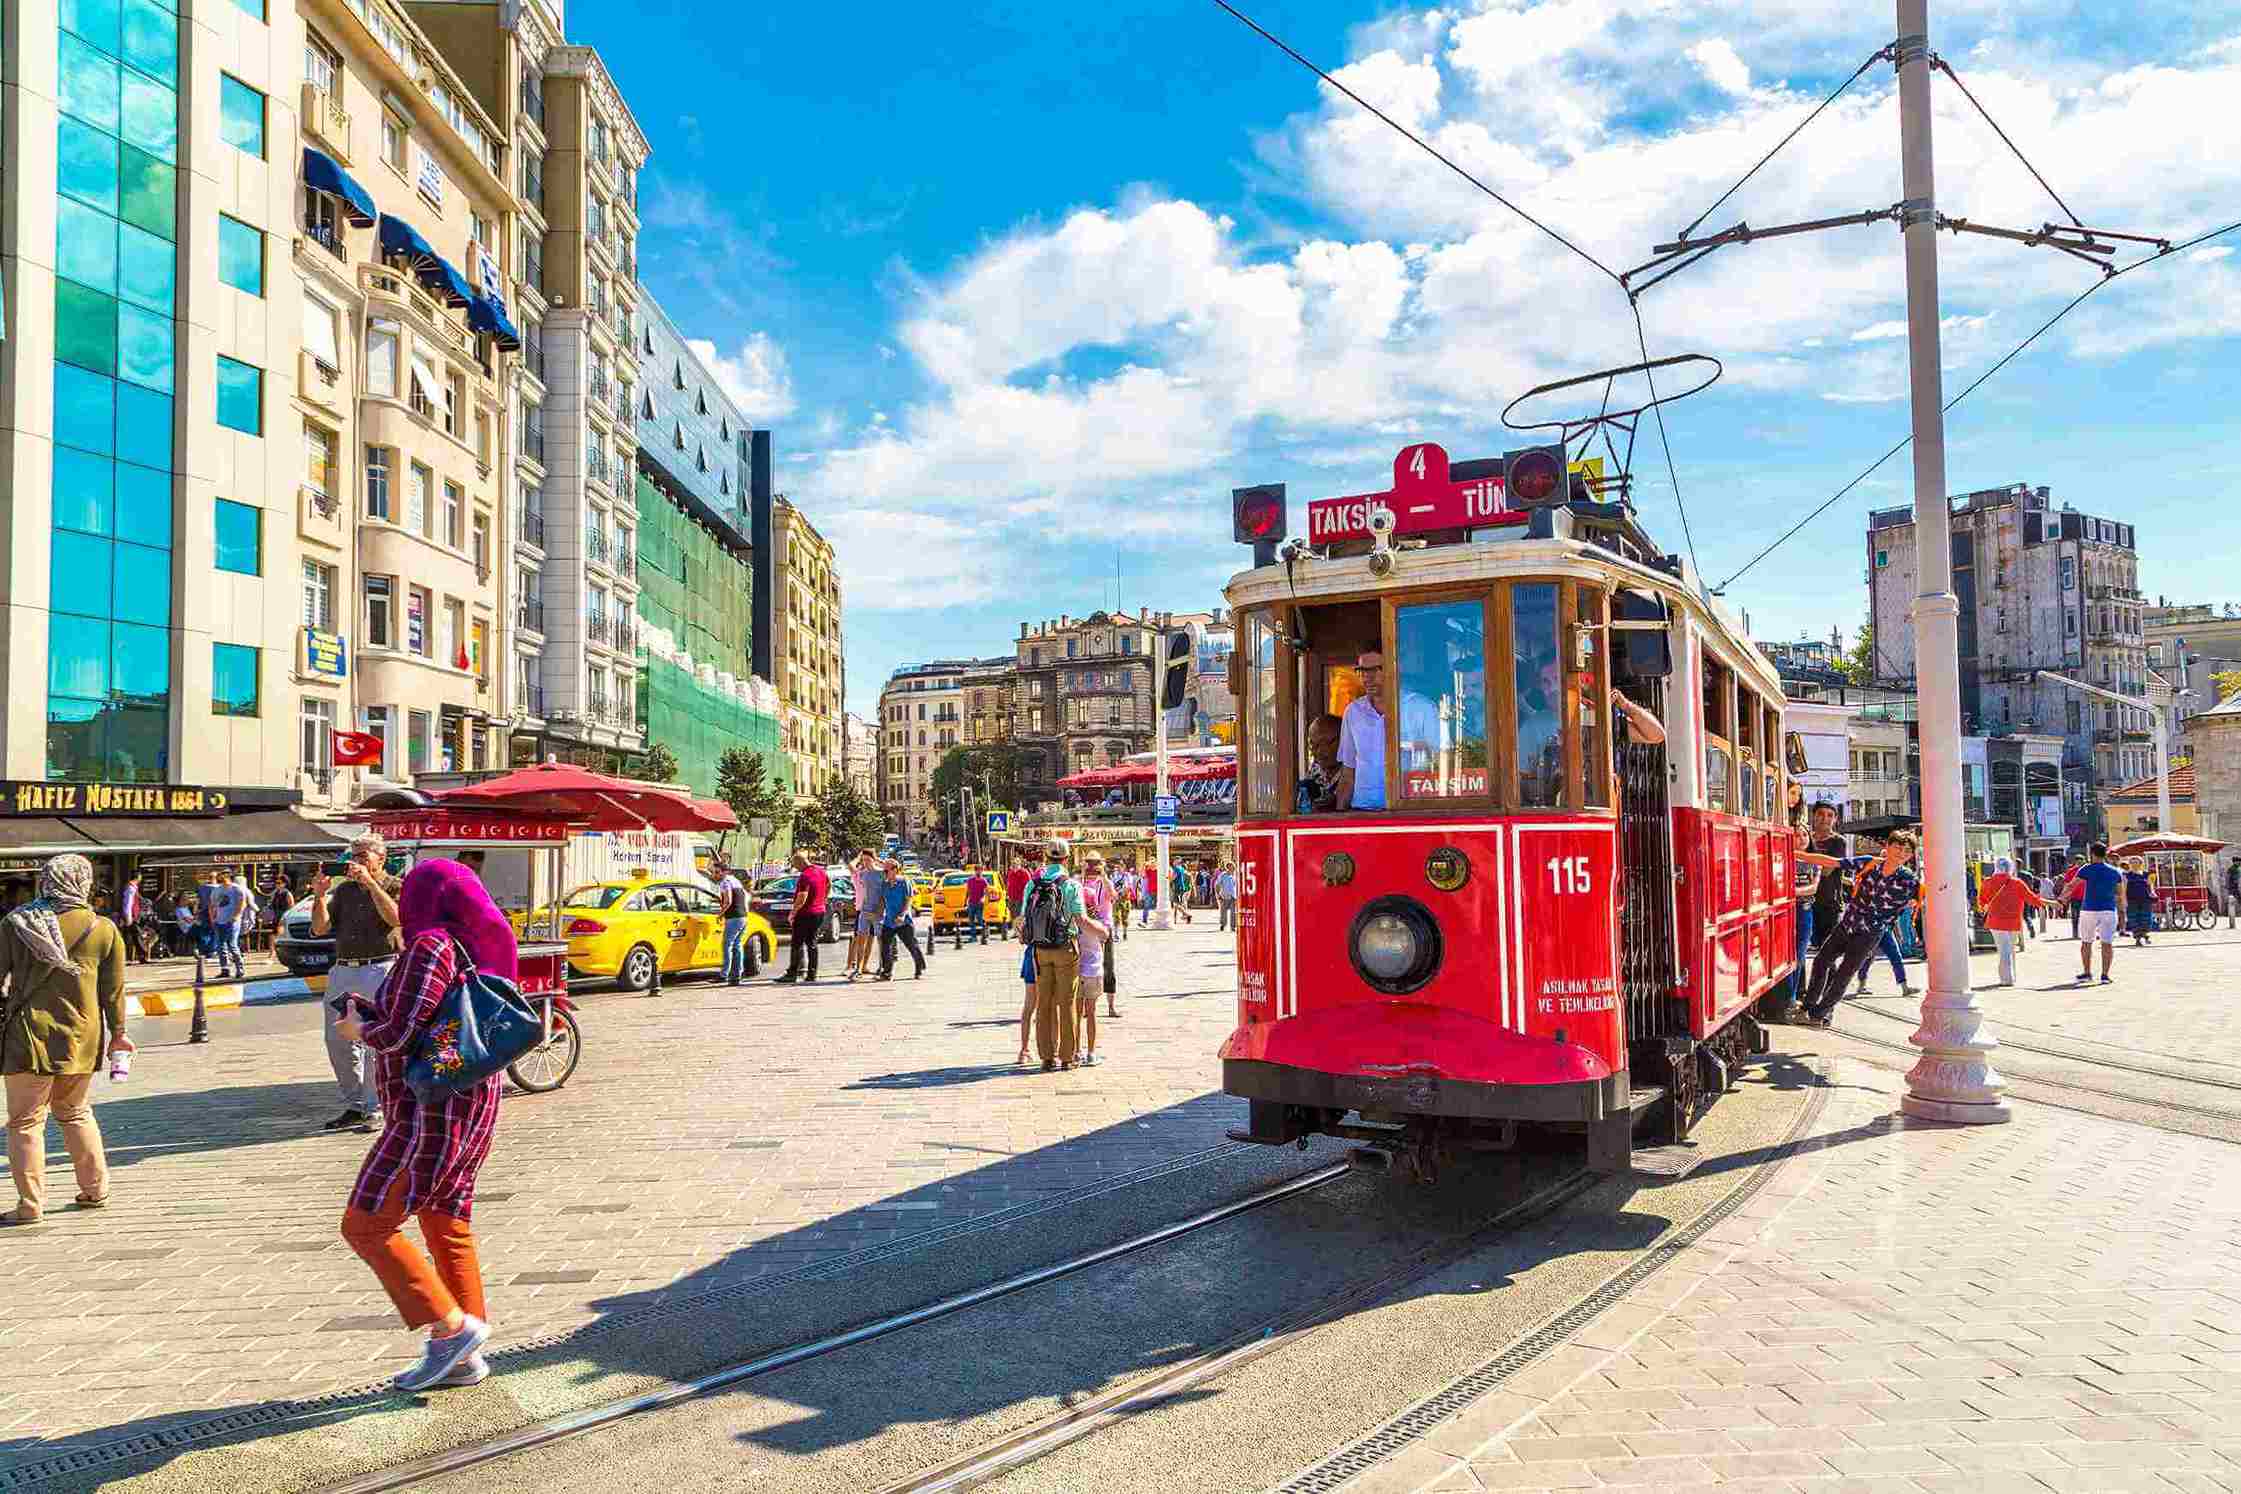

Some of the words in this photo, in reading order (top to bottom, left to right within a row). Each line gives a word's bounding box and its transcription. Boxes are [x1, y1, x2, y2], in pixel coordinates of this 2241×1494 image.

[1409, 448, 1426, 480] 4
[171, 789, 204, 811] 1864
[1548, 856, 1591, 894] 115
